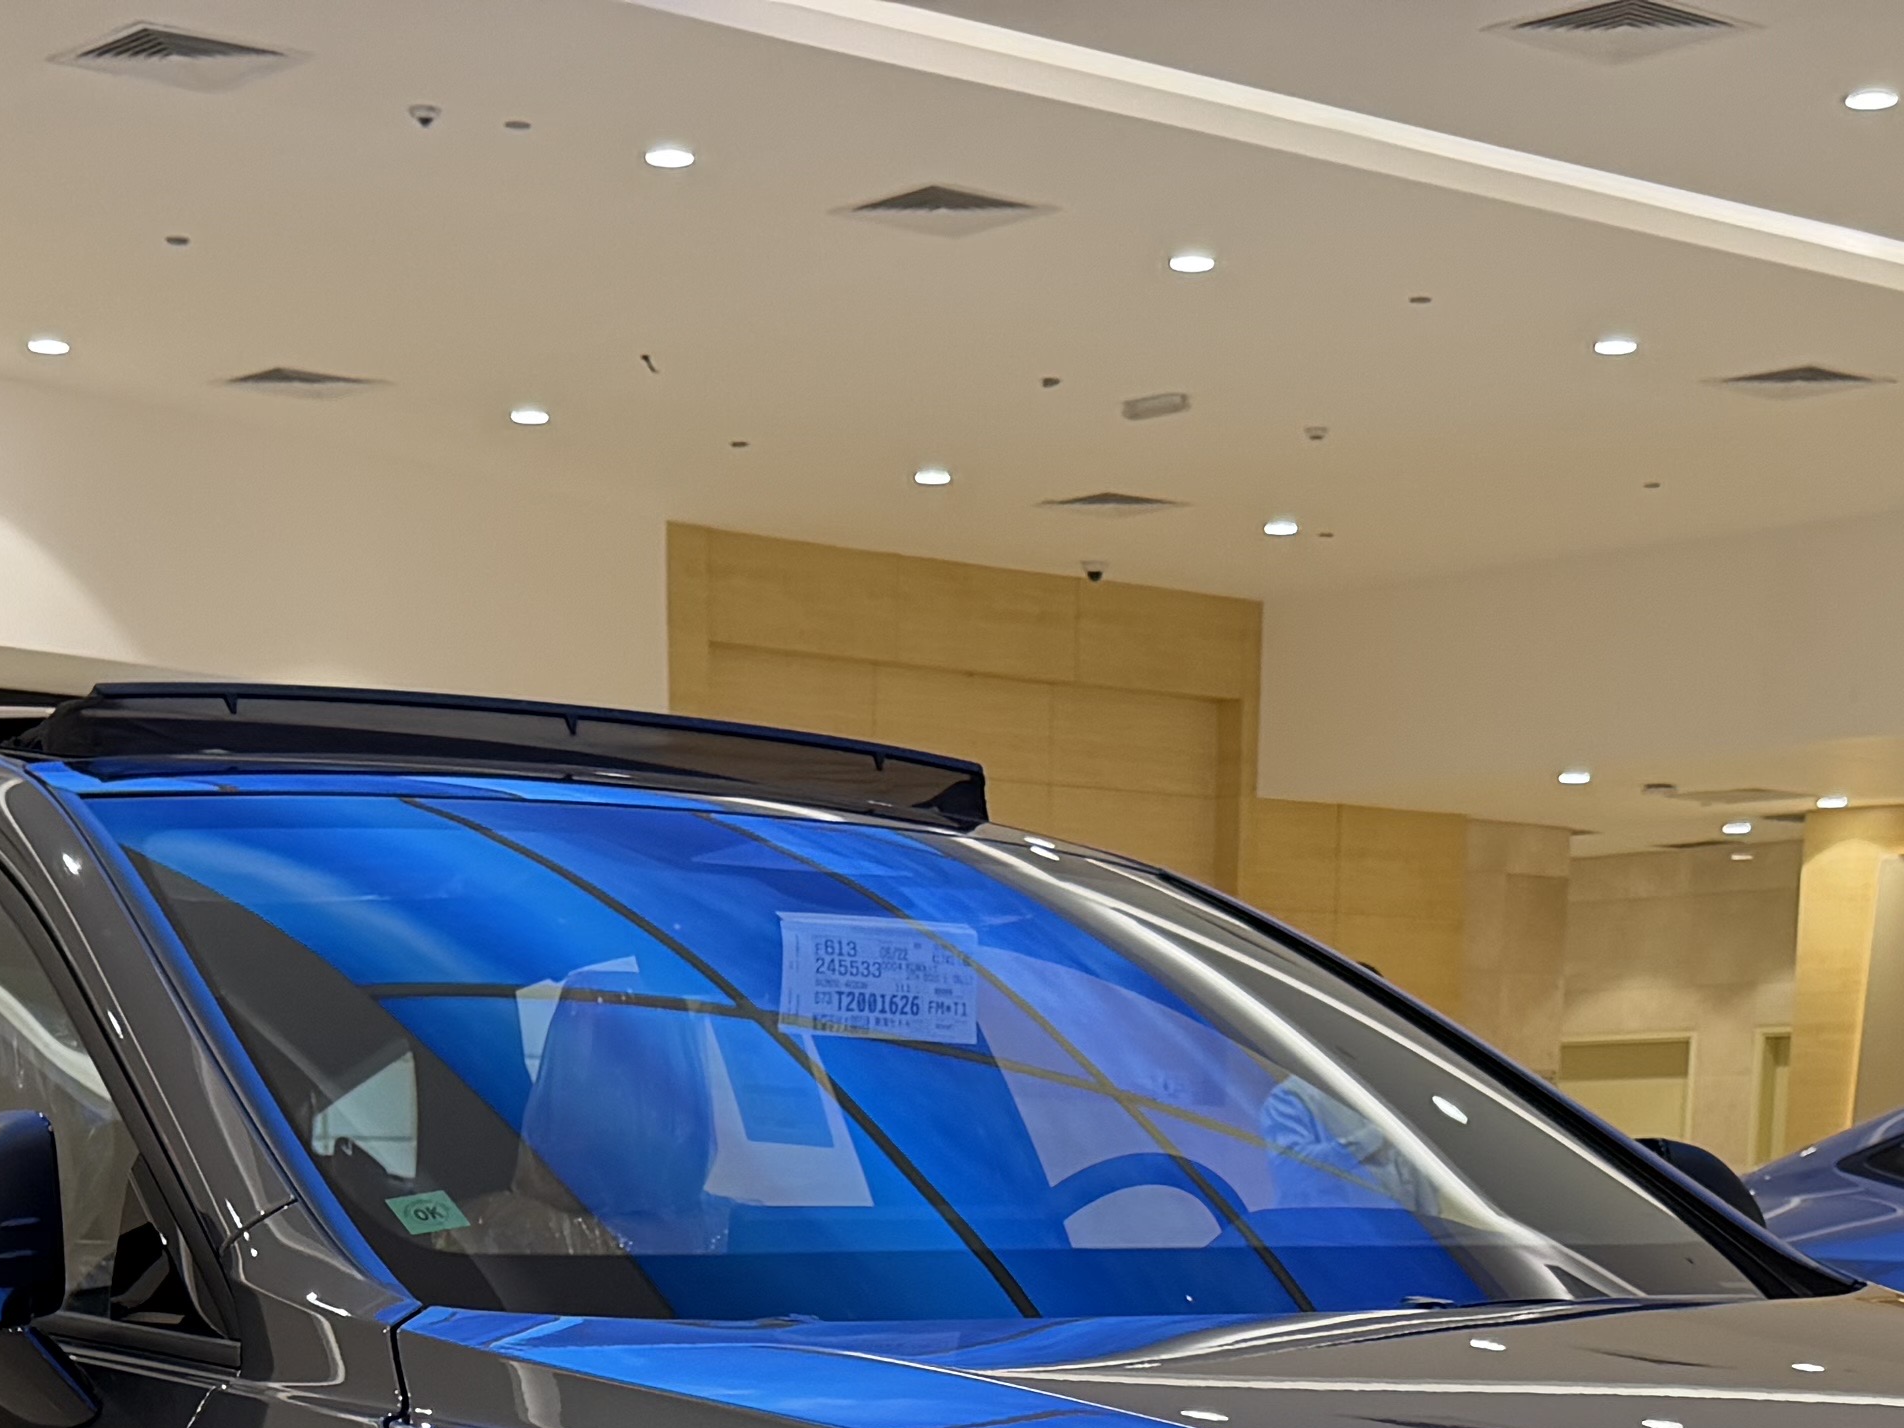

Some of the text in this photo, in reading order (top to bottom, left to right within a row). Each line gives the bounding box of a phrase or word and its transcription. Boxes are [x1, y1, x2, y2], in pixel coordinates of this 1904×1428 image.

[815, 958, 882, 979] 245533
[836, 990, 920, 1016] T2001626
[413, 1206, 445, 1222] OK
